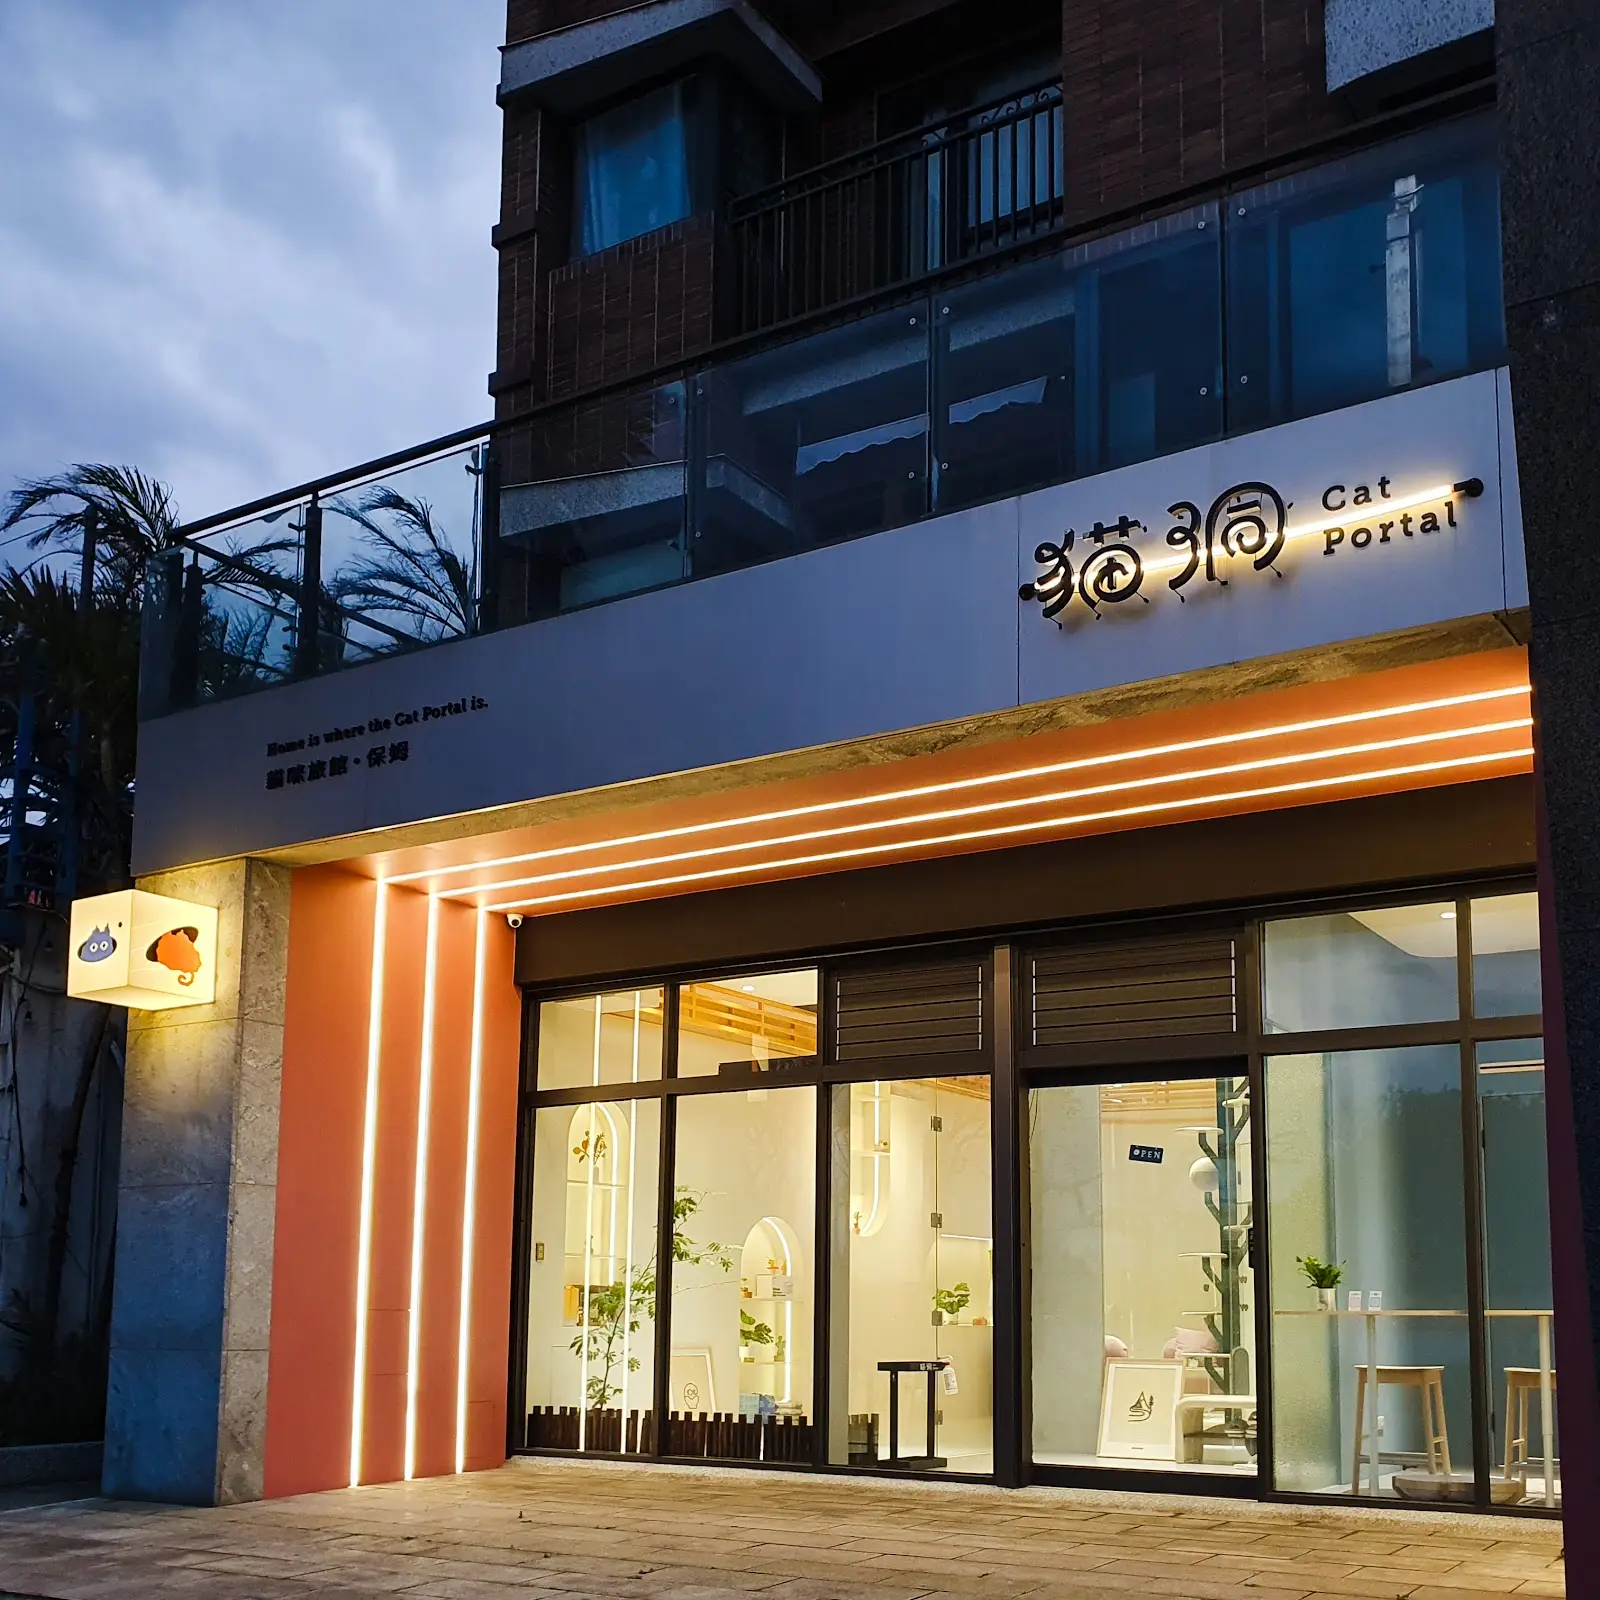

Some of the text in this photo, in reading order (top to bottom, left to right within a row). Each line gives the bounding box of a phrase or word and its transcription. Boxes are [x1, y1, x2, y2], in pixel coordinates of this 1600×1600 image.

[1321, 476, 1391, 511] Cat
[1323, 501, 1457, 556] Portal
[266, 695, 489, 757] Home is where the Cat Portal is.
[1133, 1148, 1161, 1159] OPEN
